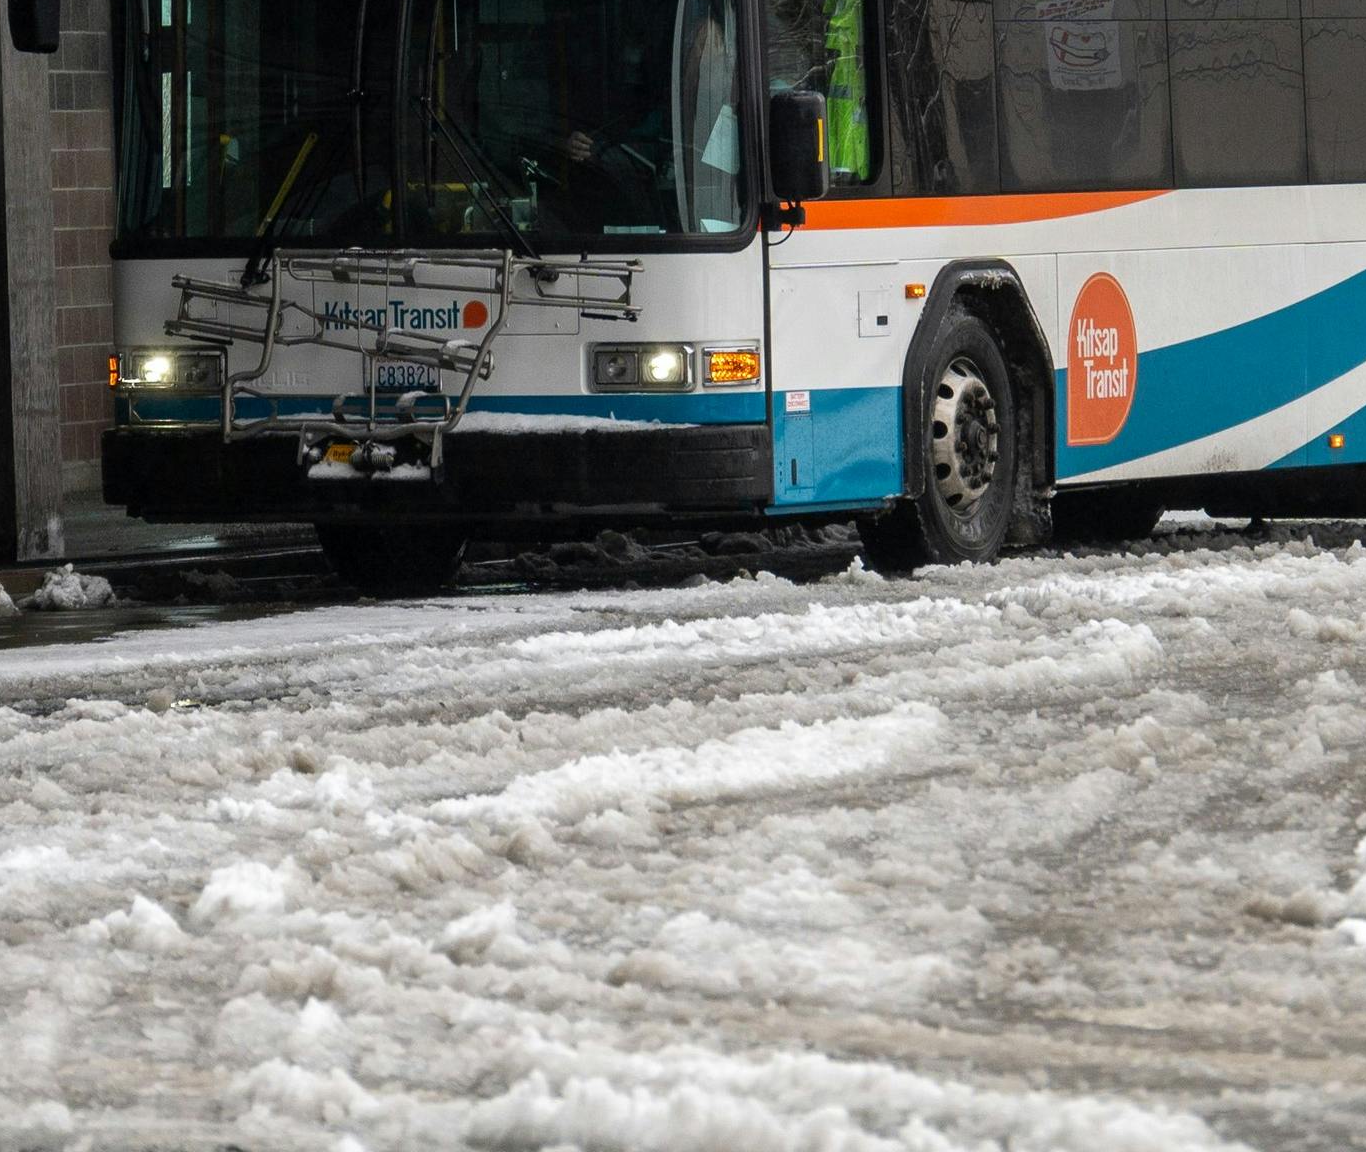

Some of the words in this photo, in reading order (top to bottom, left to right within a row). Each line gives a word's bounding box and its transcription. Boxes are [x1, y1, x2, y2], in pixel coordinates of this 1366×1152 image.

[389, 300, 460, 329] Transit
[1077, 317, 1118, 365] Kitsap
[378, 365, 436, 386] C8382C
[1084, 357, 1129, 399] Transit
